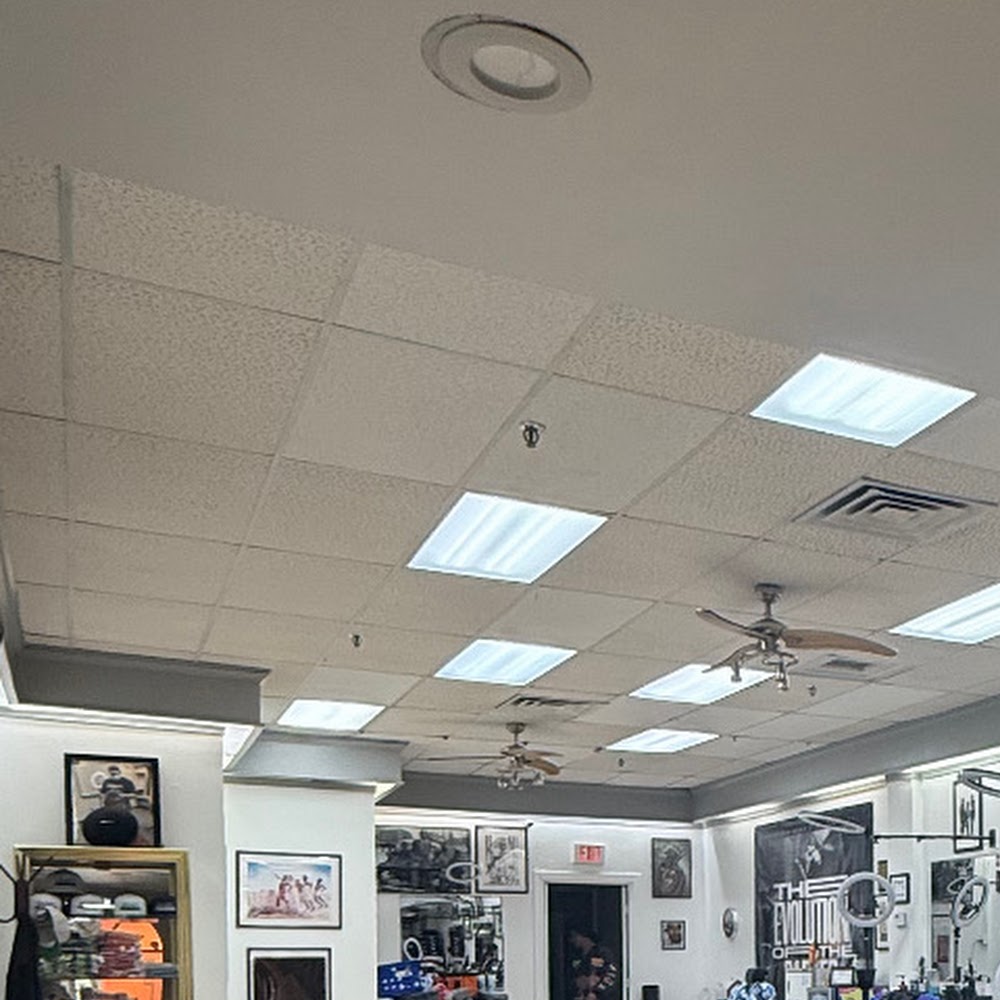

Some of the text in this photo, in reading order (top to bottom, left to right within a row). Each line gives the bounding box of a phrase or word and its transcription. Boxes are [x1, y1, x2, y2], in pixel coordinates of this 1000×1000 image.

[772, 875, 849, 900] THE
[772, 943, 854, 959] OF THE
